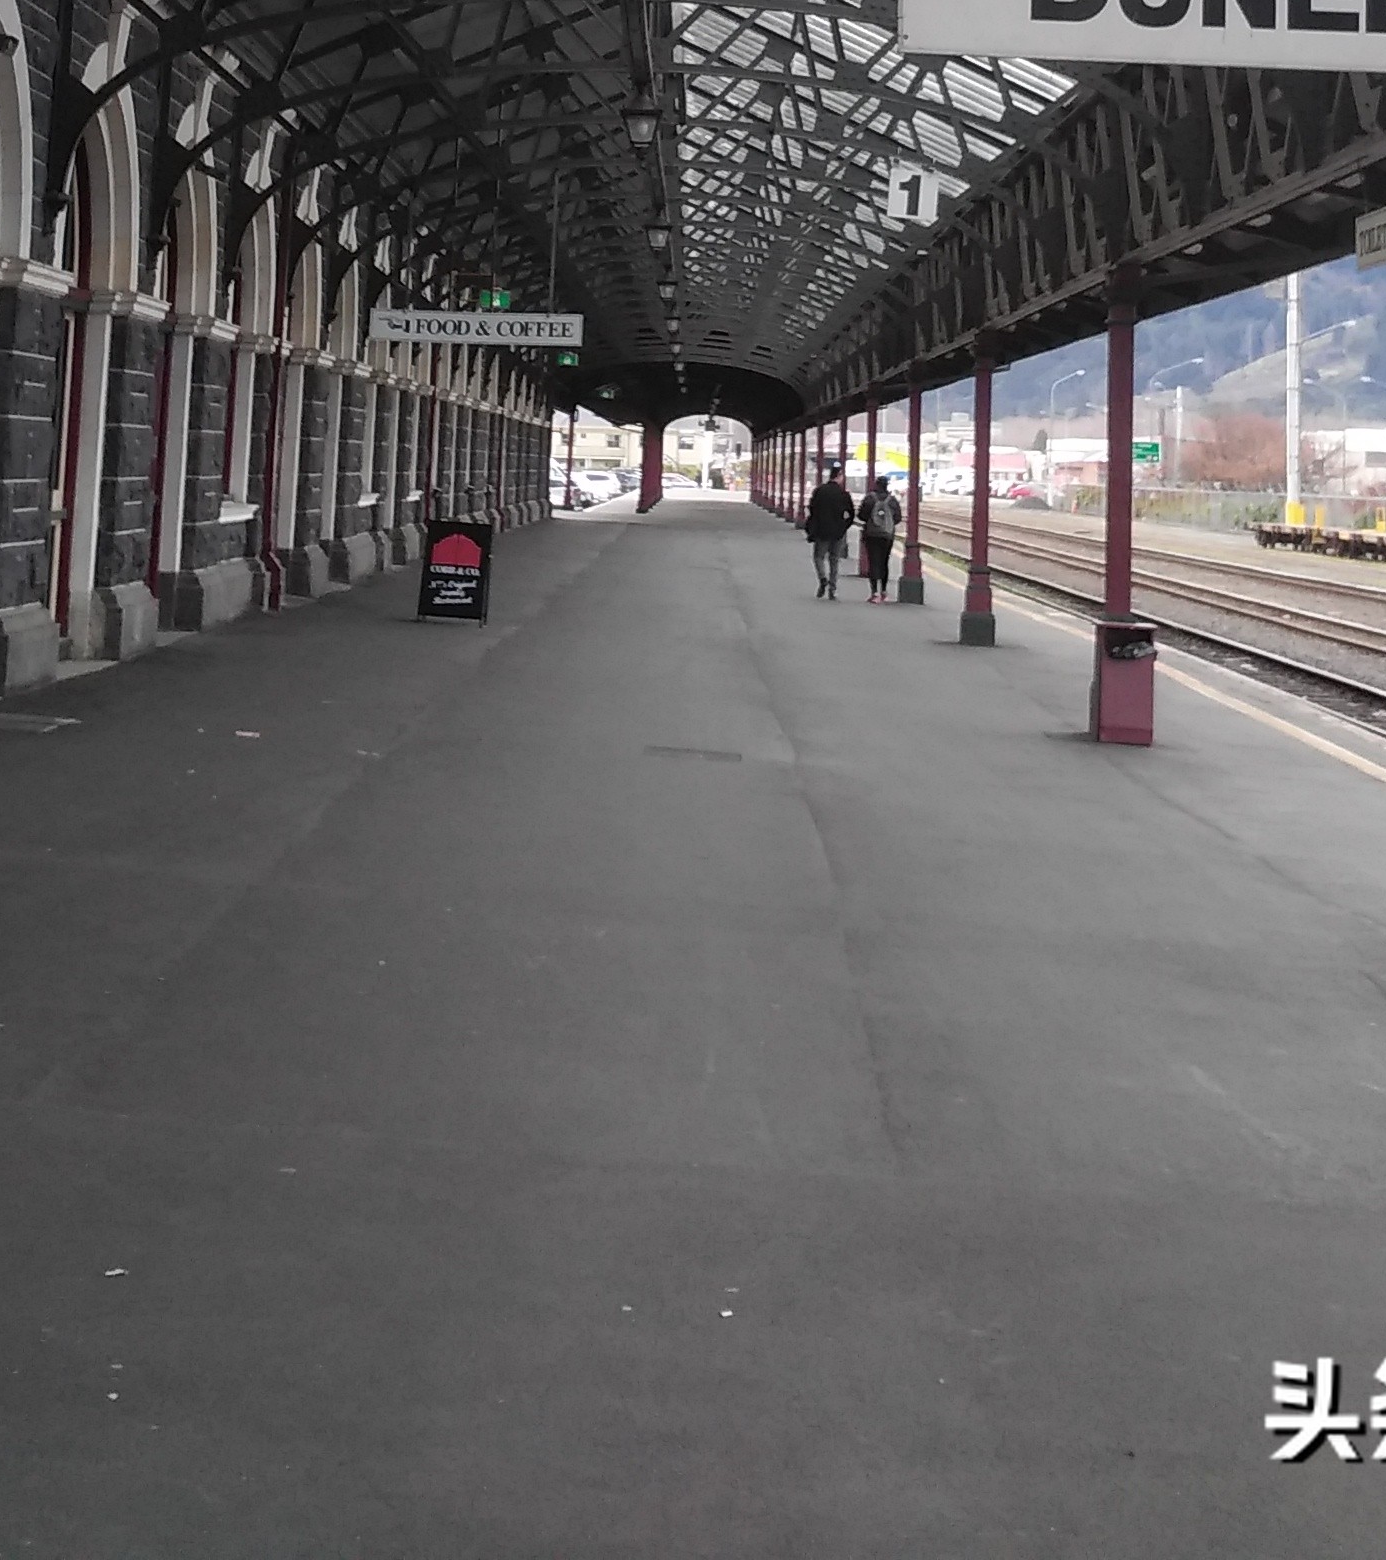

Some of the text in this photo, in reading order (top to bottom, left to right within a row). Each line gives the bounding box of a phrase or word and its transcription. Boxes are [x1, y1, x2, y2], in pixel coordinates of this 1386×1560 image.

[899, 175, 921, 216] 1
[415, 318, 574, 338] FOOD & COFFEE
